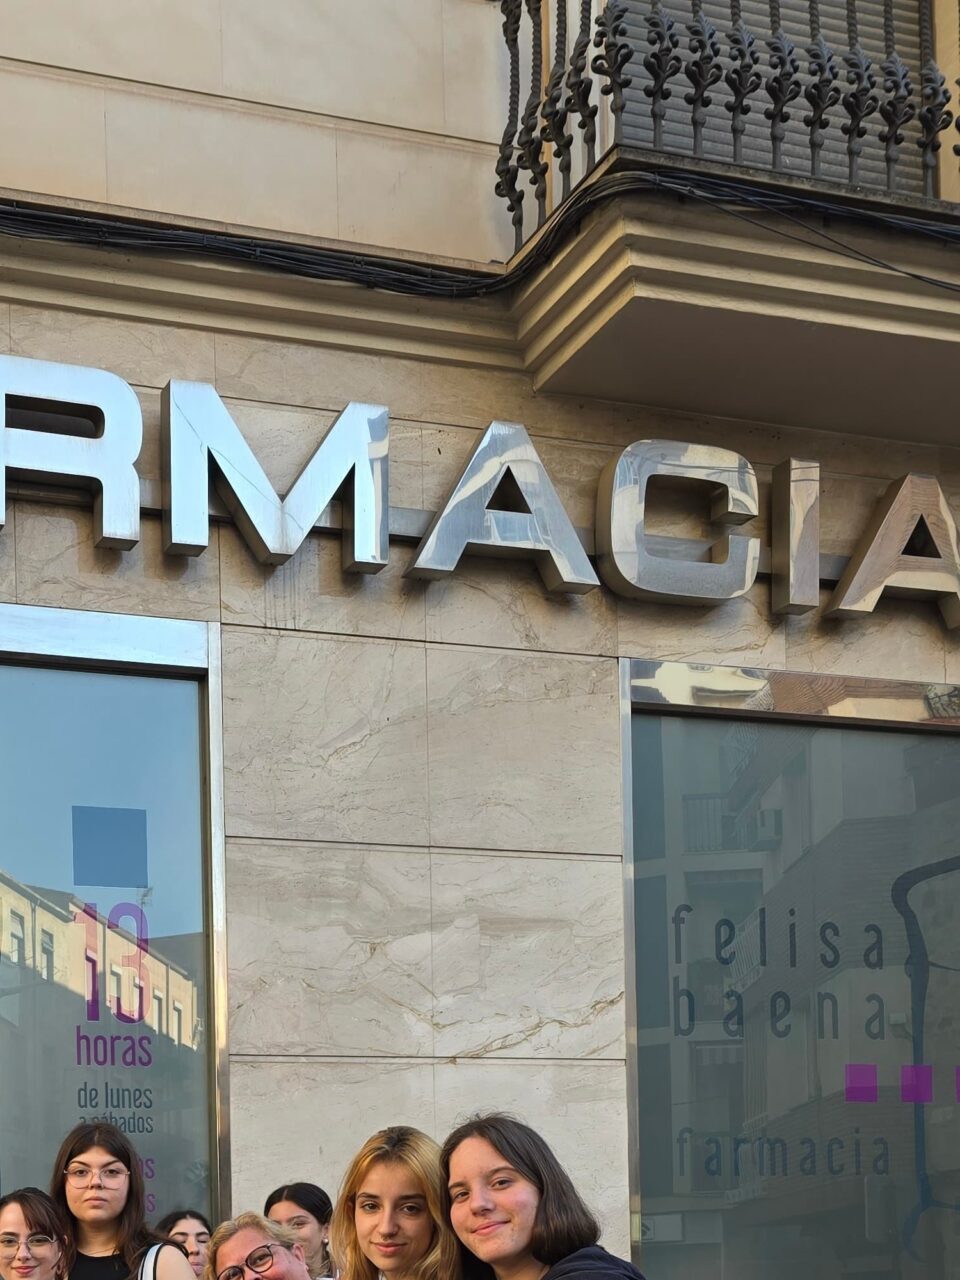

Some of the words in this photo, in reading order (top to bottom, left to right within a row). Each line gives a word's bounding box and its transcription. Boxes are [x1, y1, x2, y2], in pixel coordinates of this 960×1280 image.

[74, 901, 149, 1025] 13
[672, 903, 884, 970] felisa
[672, 975, 886, 1041] baena
[75, 1025, 153, 1068] horas
[77, 1081, 99, 1109] de
[105, 1081, 154, 1109] lunes
[676, 1126, 890, 1178] farmacia
